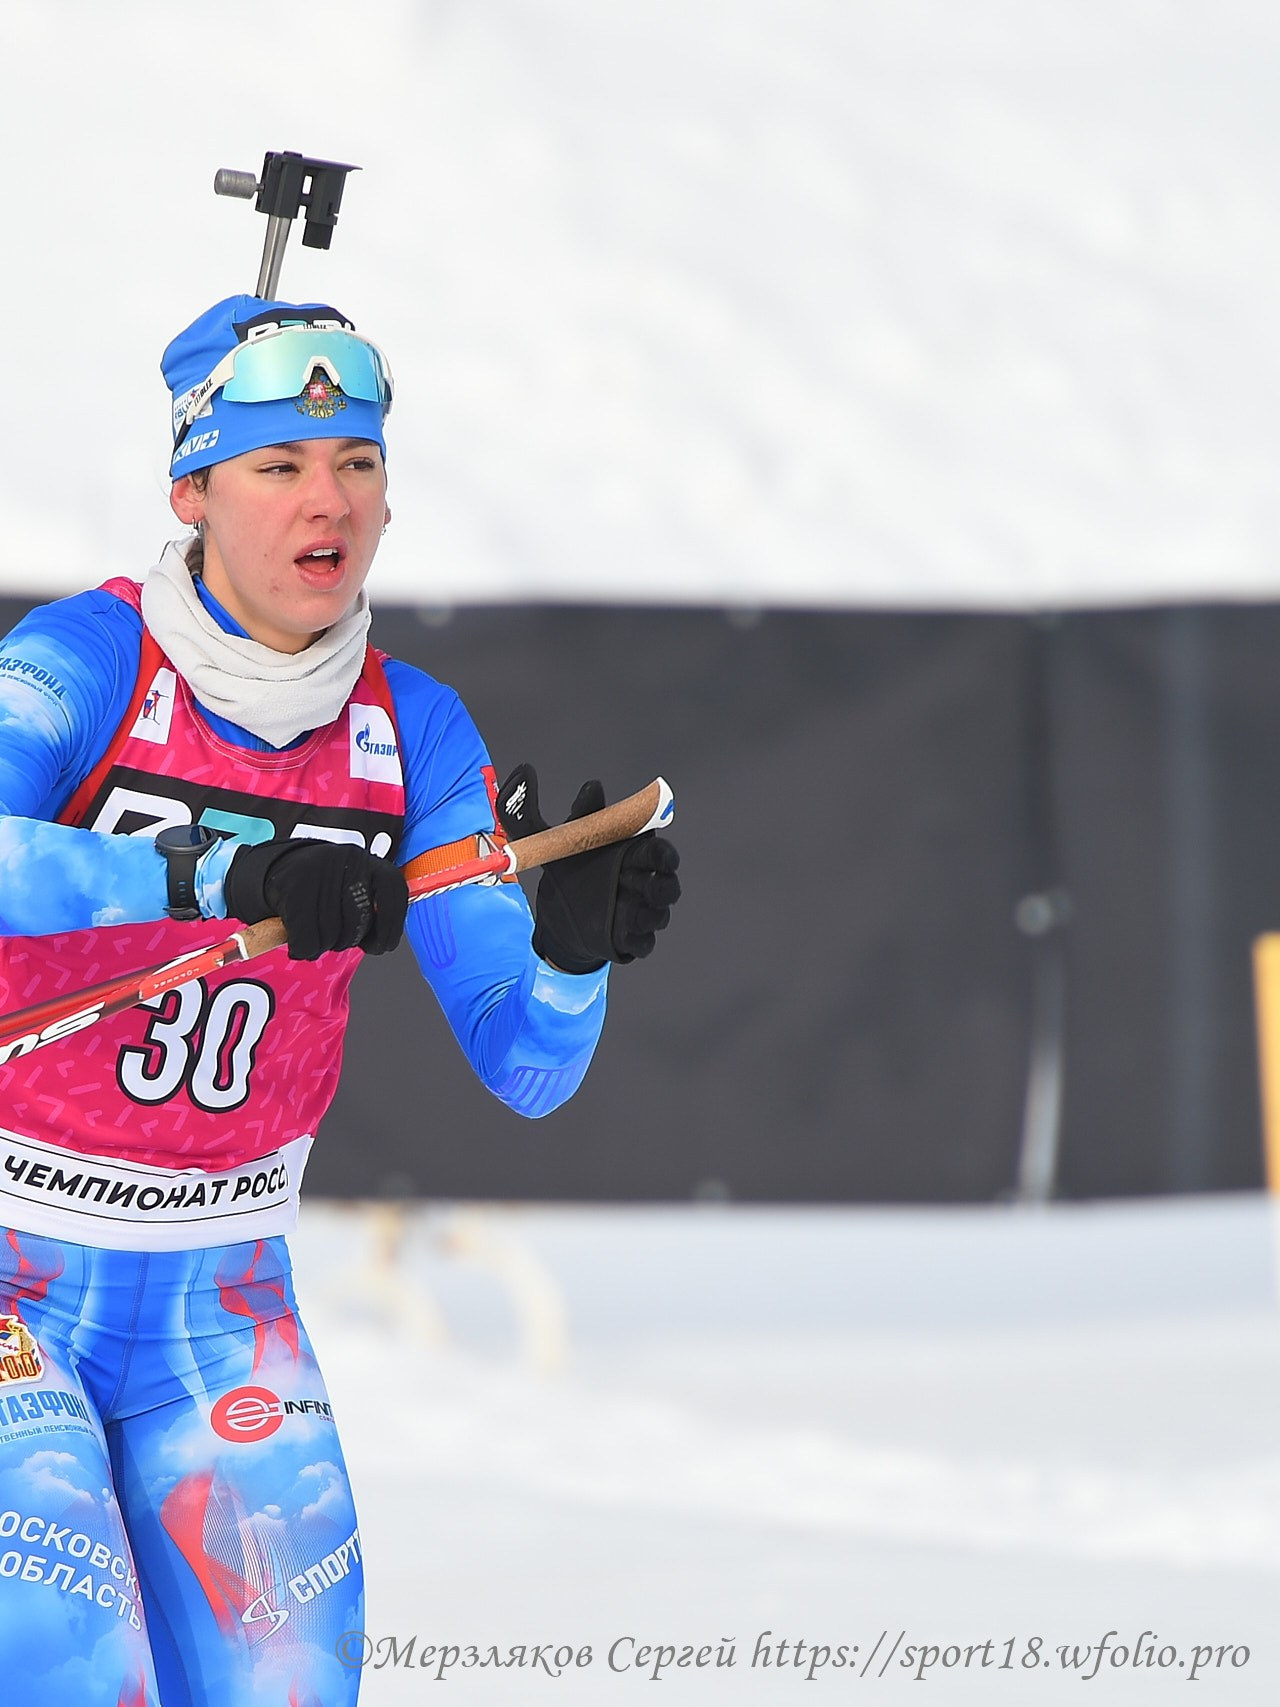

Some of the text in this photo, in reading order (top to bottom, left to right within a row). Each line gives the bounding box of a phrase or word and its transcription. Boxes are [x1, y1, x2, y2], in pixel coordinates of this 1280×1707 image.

[117, 975, 275, 1113] 30
[4, 1155, 229, 1211] ЧЕМПИОНАТ
[230, 1163, 289, 1202] РОСС
